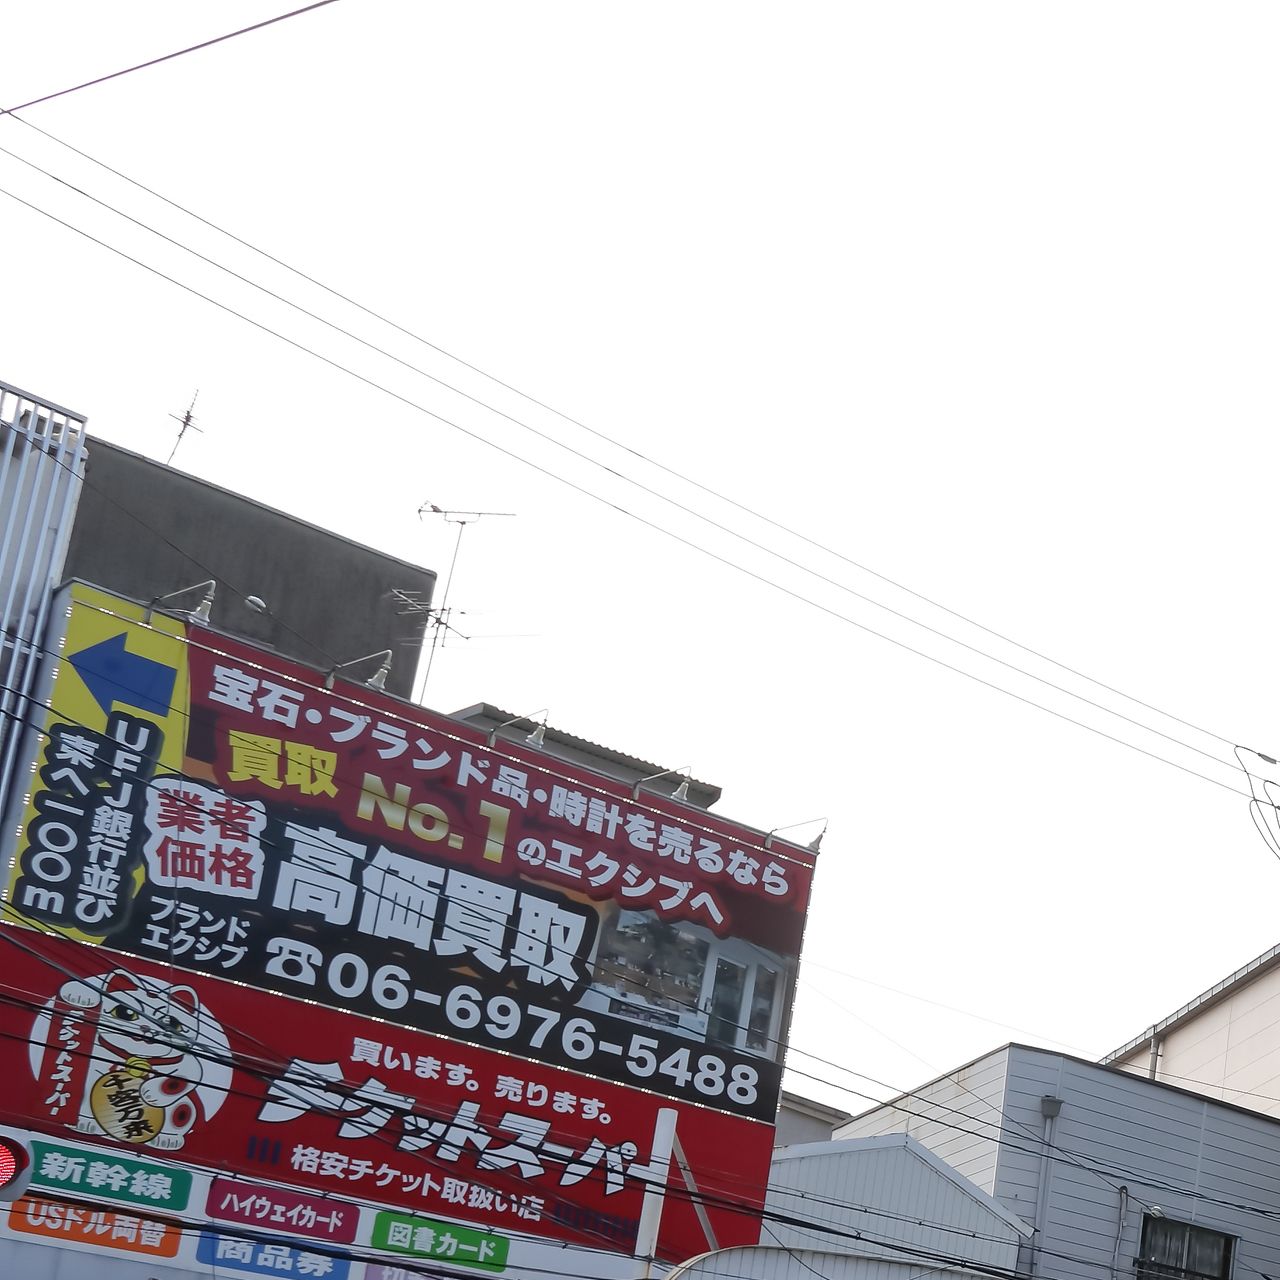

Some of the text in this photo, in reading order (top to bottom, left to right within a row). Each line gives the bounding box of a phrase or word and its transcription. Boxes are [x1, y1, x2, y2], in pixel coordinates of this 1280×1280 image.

[208, 664, 789, 896] 宝石・ブランド品・時計を売るなら
[75, 720, 150, 923] UFJ銀行並び
[157, 788, 256, 844] 業者
[226, 730, 724, 926] 買取 No.1 のエクシブへ
[156, 835, 256, 890] 価格
[150, 896, 251, 943] ブランド
[271, 821, 588, 993] 高価買取
[141, 924, 249, 969] エクシブ
[327, 952, 759, 1105] 06-6976-5488
[348, 1037, 612, 1125] 買います。 売ります。
[39, 1151, 173, 1201] 新幹線
[291, 1143, 545, 1223] 格安チケット取扱い店
[220, 1191, 345, 1234] ハイウェイカード
[387, 1220, 495, 1263] 図書カード
